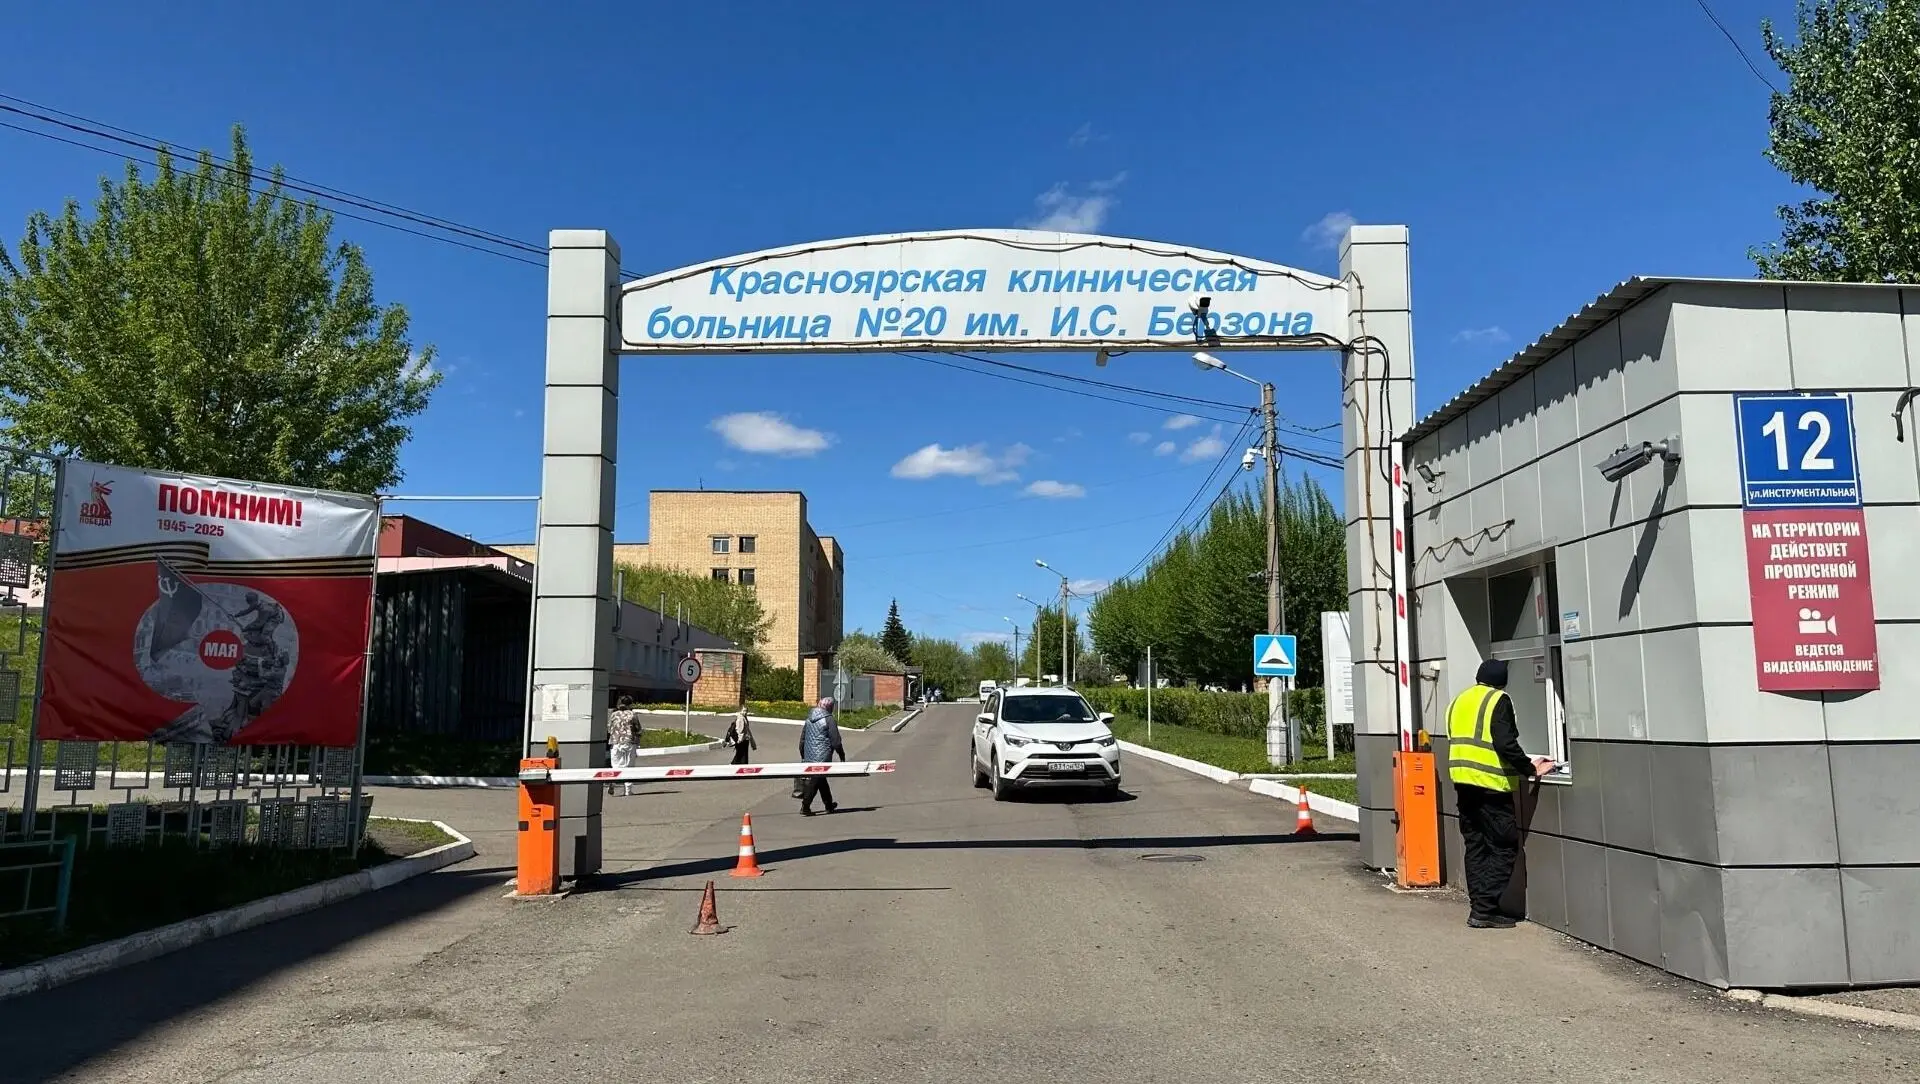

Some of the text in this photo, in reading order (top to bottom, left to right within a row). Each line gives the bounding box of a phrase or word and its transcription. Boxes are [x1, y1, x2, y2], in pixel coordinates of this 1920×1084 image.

[710, 267, 1258, 302] Красноярская клиническая
[647, 306, 832, 341] больница
[855, 306, 947, 337] №20
[964, 312, 1028, 337] им.
[1050, 305, 1126, 337] И.С.
[1762, 411, 1835, 471] 12
[158, 483, 303, 527] ПОМНИМ!
[79, 516, 112, 527] ПОБЕДА!
[1752, 522, 1860, 538] НА ТЕРРИТОРИИ
[1770, 541, 1848, 560] ДЕЙСТВУЕТ
[1764, 561, 1857, 579] ПРОПУСКНОЙ
[1788, 584, 1840, 599] РЕЖИМ
[203, 641, 239, 658] МАЯ
[1795, 644, 1844, 657] ВЕДЕТСЯ
[686, 665, 694, 676] 5
[1763, 660, 1874, 675] ВИДЕОНАБЛЮДЕНИЕ
